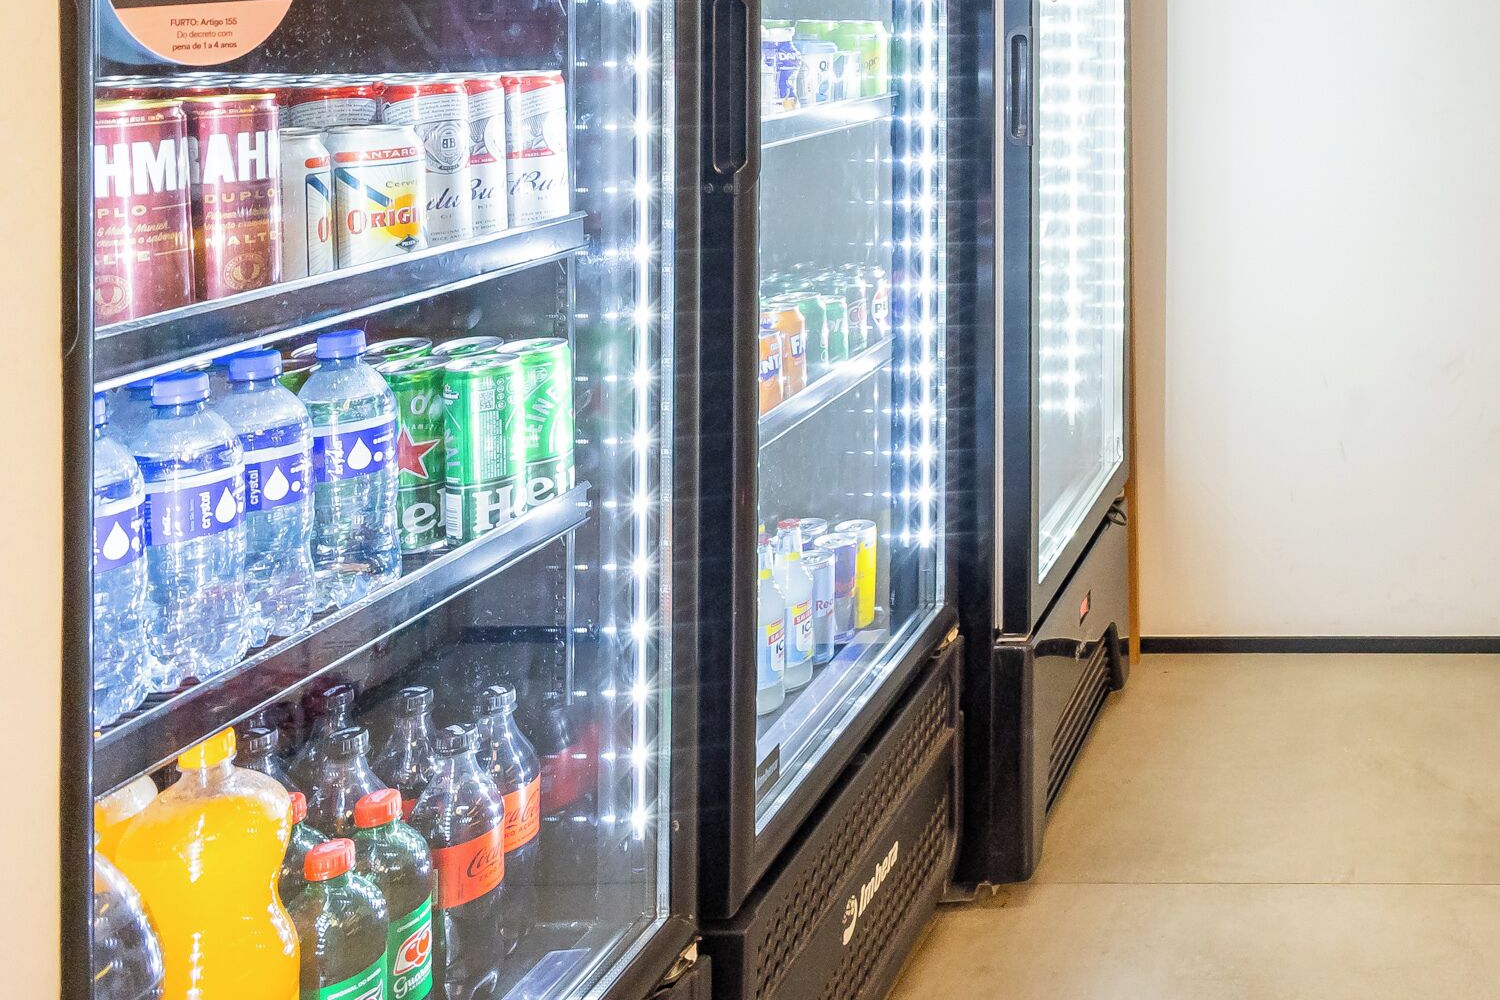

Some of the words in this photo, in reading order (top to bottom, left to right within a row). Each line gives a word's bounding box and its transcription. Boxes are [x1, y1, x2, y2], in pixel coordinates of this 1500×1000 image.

[170, 18, 198, 27] FURTO:
[200, 18, 224, 28] Artigo
[225, 17, 238, 26] 155
[177, 30, 188, 39] Do
[188, 30, 217, 39] decreto
[217, 30, 233, 38] com
[172, 43, 191, 52] pena
[192, 42, 202, 50] de
[220, 41, 238, 49] anos
[204, 188, 277, 204] DUPLO
[249, 469, 260, 506] crystal
[199, 491, 212, 530] crystal
